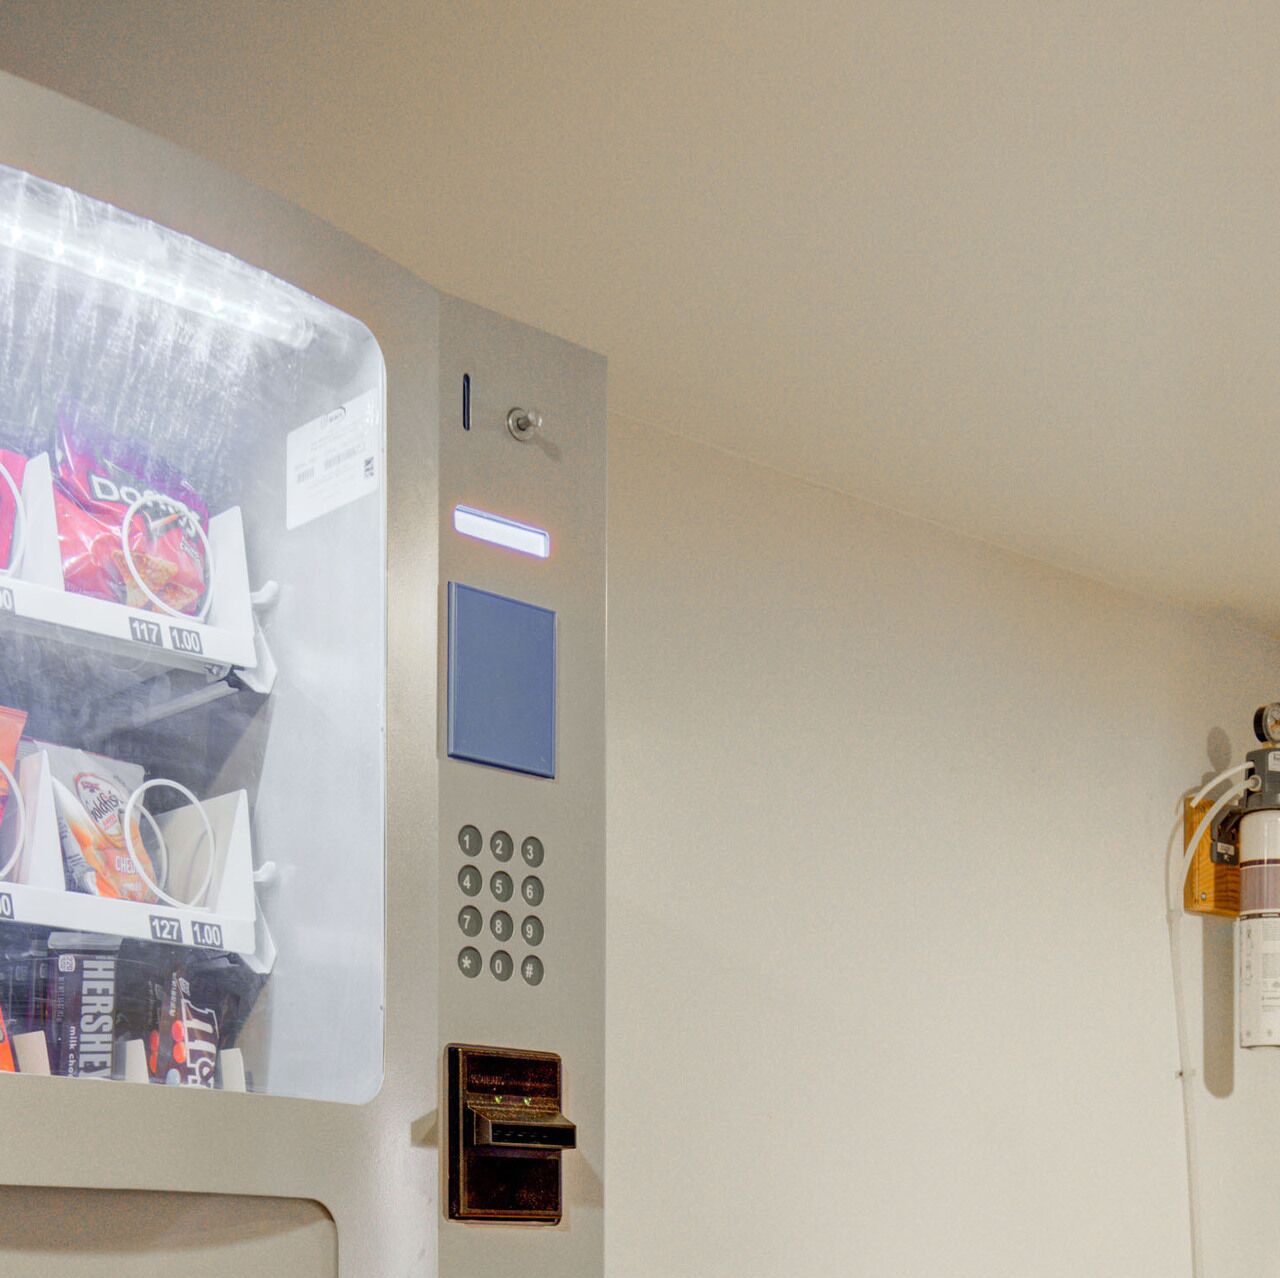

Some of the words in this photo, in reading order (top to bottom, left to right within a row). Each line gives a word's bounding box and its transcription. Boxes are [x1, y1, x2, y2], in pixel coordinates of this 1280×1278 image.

[133, 621, 159, 643] 117
[172, 629, 201, 652] 1.00
[464, 835, 469, 849] 1
[496, 840, 503, 854] 2
[527, 845, 534, 859] 3
[463, 875, 471, 889] 4
[496, 880, 503, 894] 5
[527, 885, 533, 898] 6
[152, 919, 180, 940] 127
[193, 924, 220, 946] 1.00
[463, 916, 470, 929] 7
[495, 920, 502, 934] 8
[526, 925, 533, 938] 9
[495, 960, 502, 973] 0
[68, 1026, 78, 1049] milk
